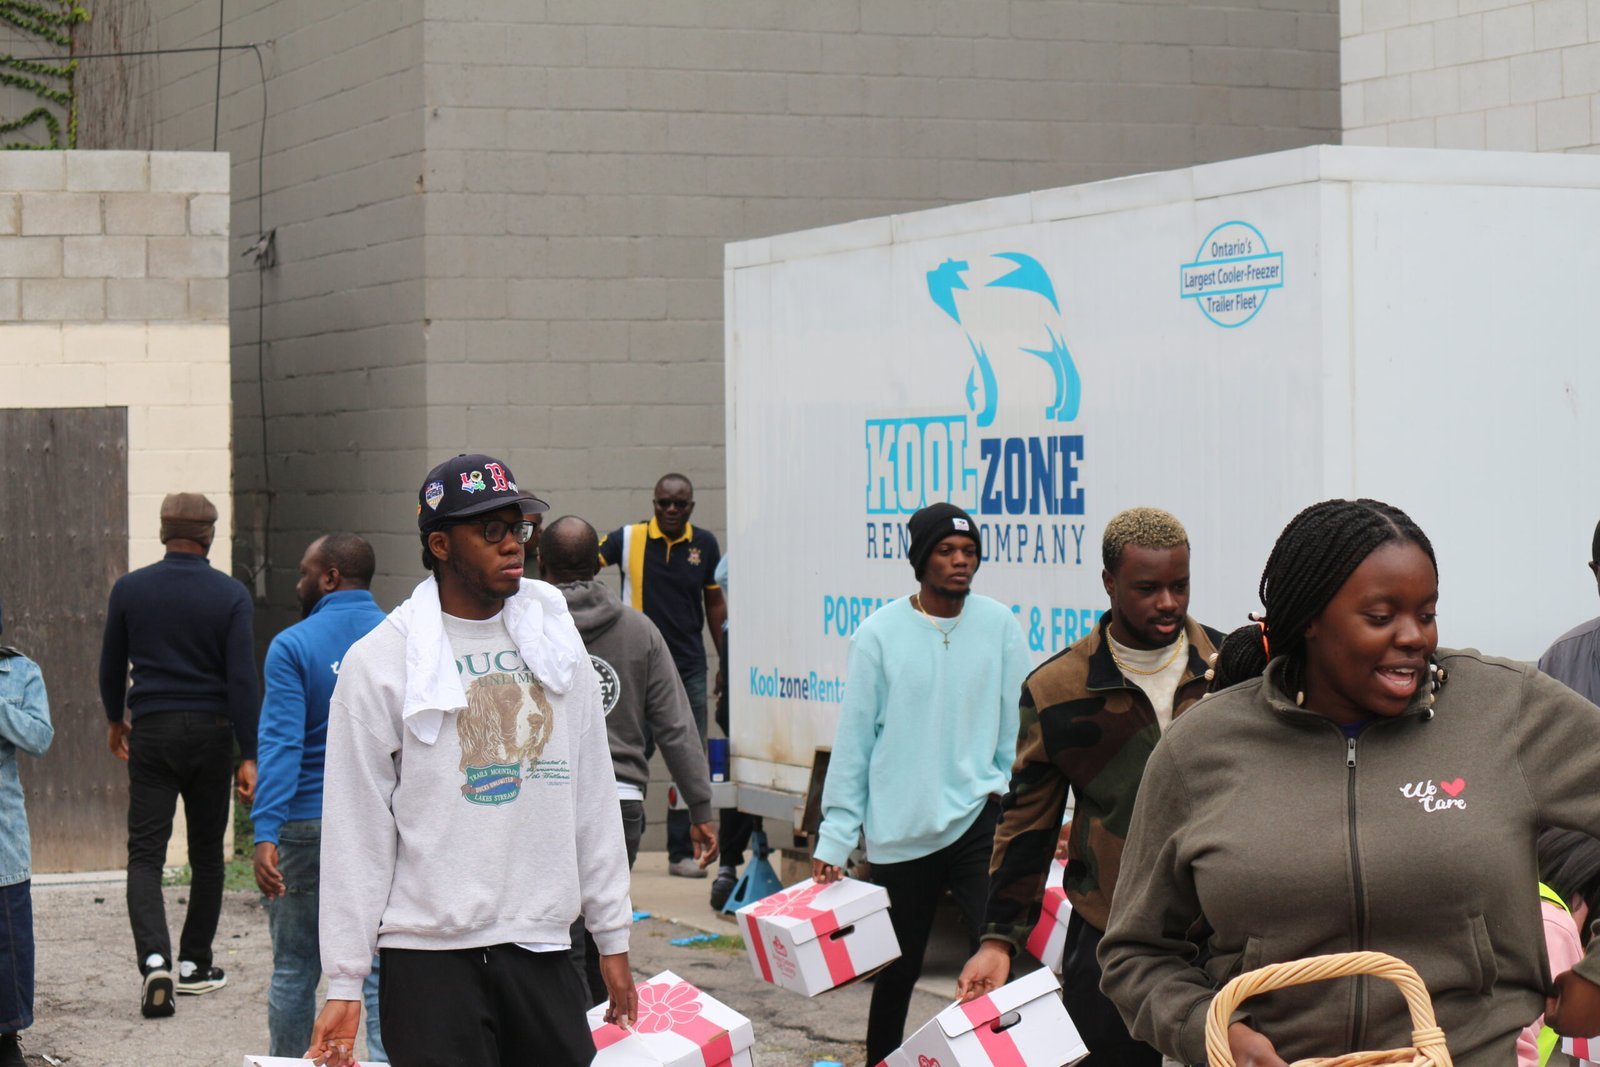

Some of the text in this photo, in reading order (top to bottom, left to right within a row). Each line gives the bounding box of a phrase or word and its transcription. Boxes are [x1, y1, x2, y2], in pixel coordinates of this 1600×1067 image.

[1211, 238, 1252, 257] Ontario's
[1184, 265, 1279, 291] Largest Cooler-Freezer
[1207, 293, 1257, 313] Trailer Fleet
[866, 415, 1085, 515] KOOL ZONE
[867, 523, 1085, 564] REN OMPANY
[1028, 606, 1045, 652] &
[474, 794, 492, 802] LAKES
[1400, 780, 1437, 798] We
[1419, 796, 1467, 812] Care
